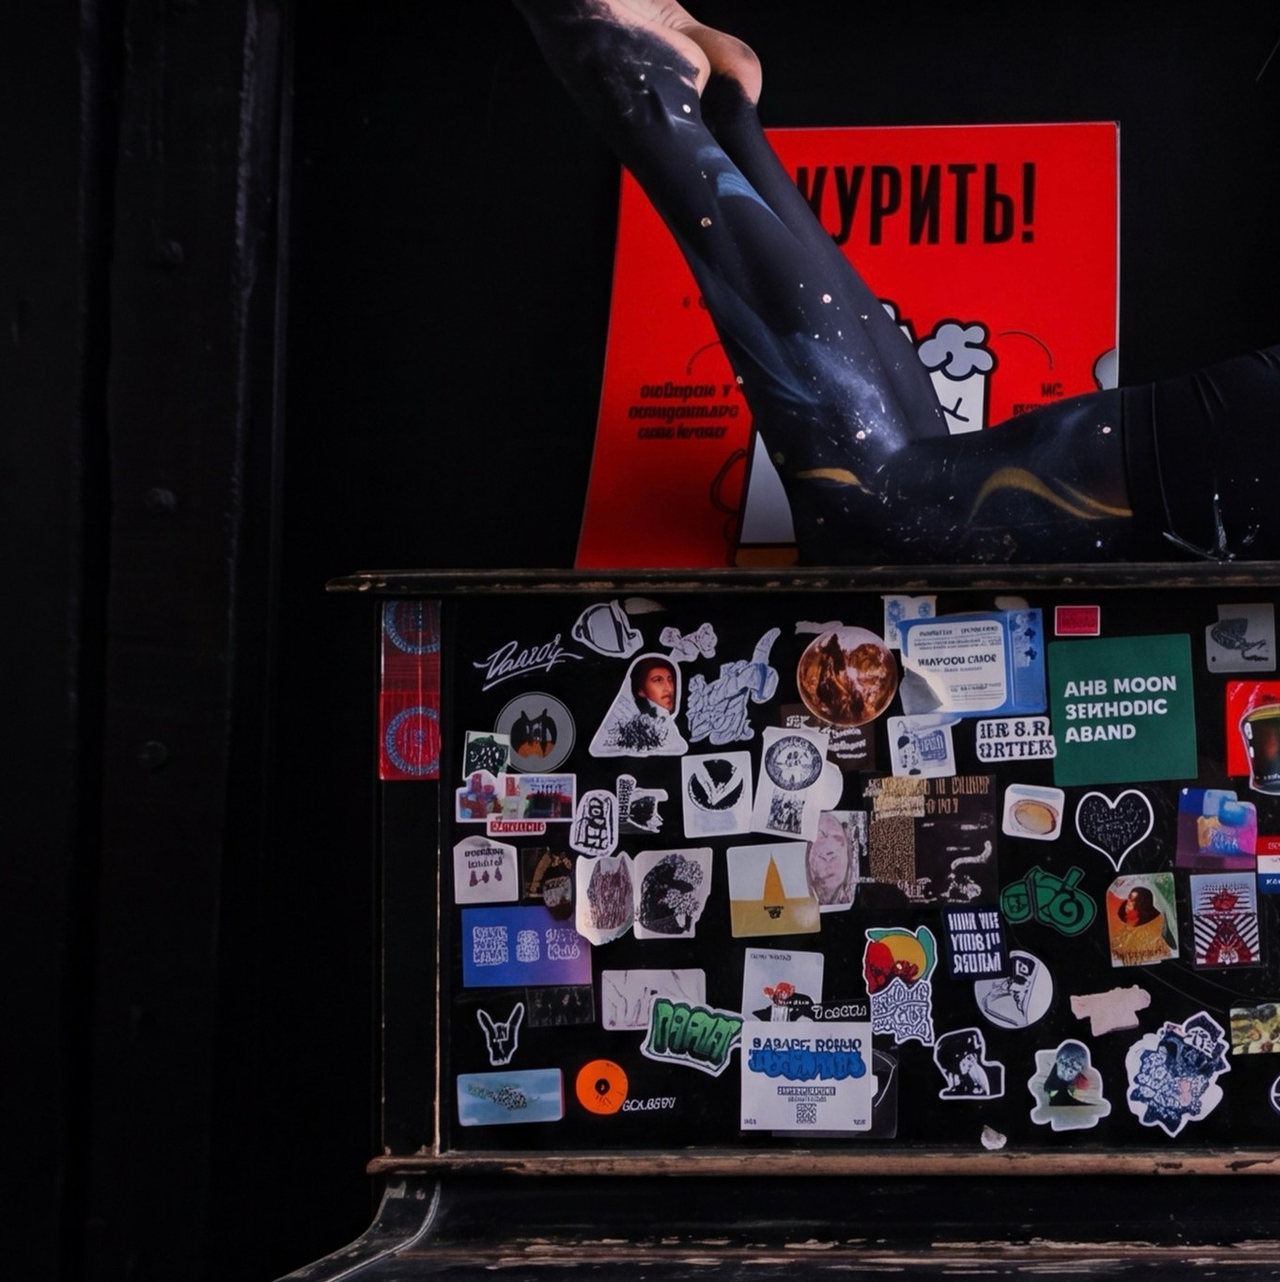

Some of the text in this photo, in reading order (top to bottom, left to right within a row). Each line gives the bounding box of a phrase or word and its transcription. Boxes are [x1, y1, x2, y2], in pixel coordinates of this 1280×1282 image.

[1064, 675, 1177, 698] AHB MOON
[1065, 723, 1136, 743] ABAND
